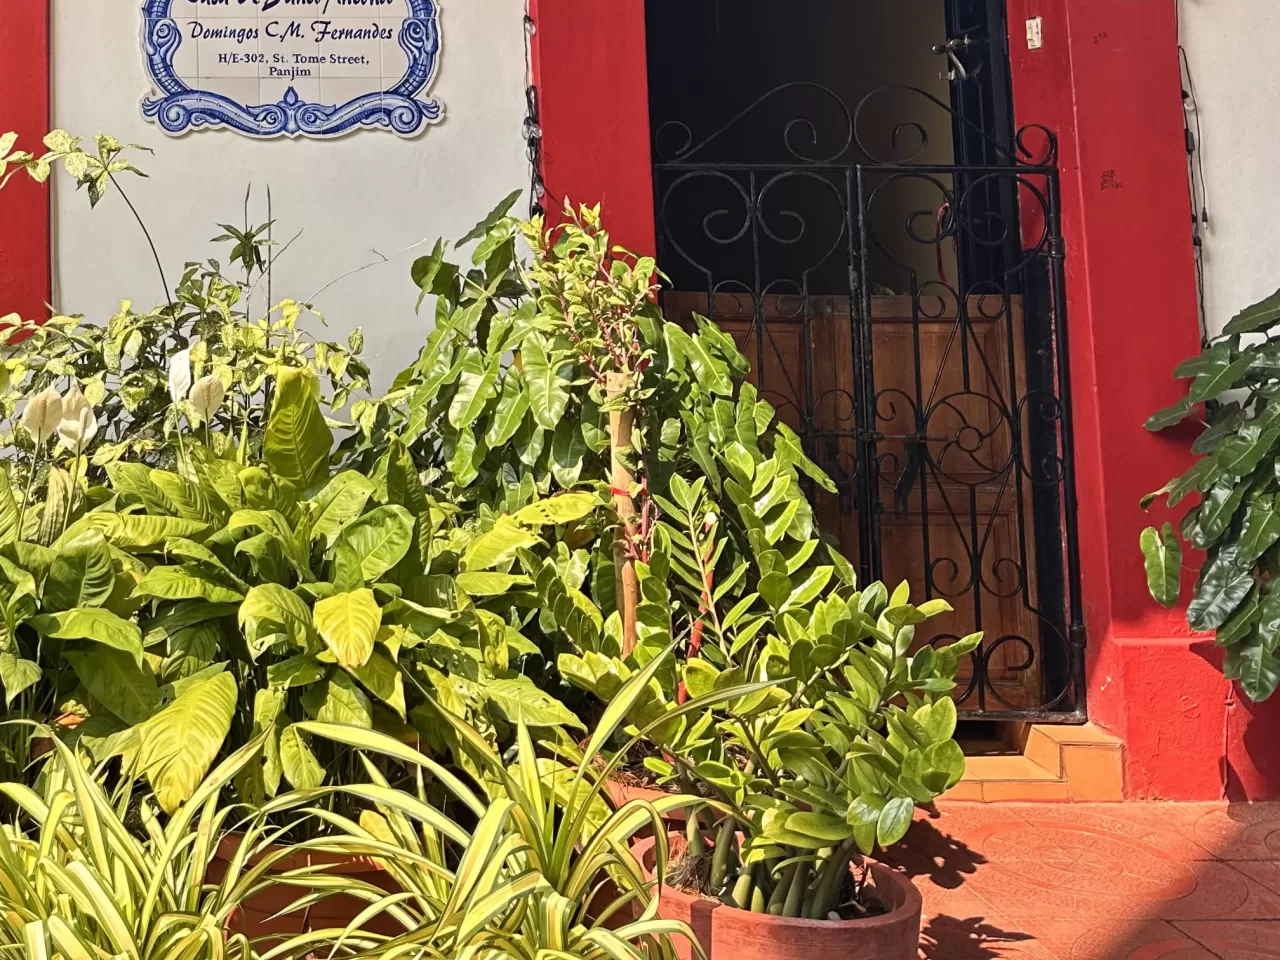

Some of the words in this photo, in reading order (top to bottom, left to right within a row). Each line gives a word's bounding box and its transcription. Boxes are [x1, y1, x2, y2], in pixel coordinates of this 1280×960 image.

[187, 21, 259, 44] Domingos
[311, 21, 393, 43] Fernandes
[218, 53, 269, 65] H/E-302,
[273, 53, 289, 63] St.
[292, 53, 326, 64] Tome
[329, 53, 370, 65] Street,
[269, 66, 311, 81] Panjim
